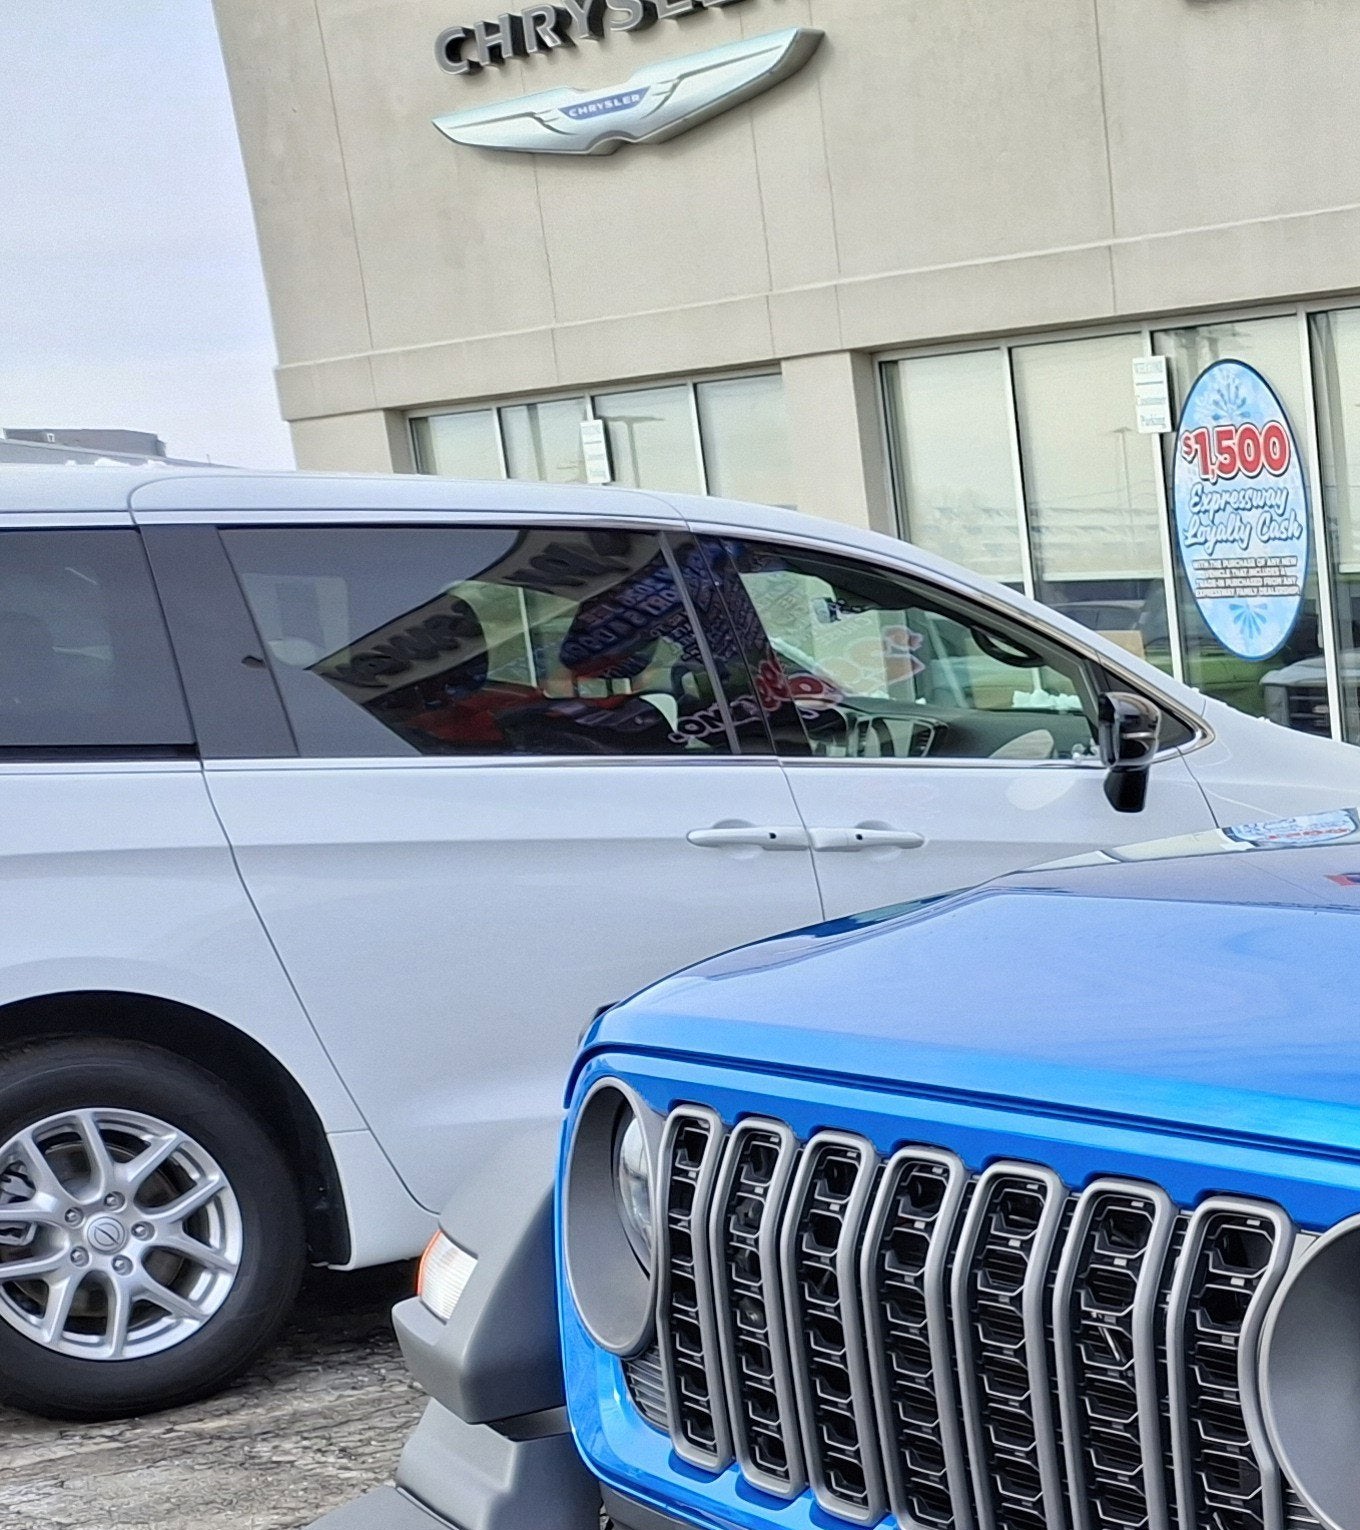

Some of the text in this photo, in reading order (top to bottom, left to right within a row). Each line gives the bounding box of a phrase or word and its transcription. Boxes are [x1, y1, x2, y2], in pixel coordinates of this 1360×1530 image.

[434, 0, 728, 75] CHRYS
[568, 94, 640, 117] CHRYSLER
[1182, 421, 1290, 484] $1,500
[1189, 482, 1289, 520] Expressway
[1183, 508, 1303, 556] Loyalty Cash
